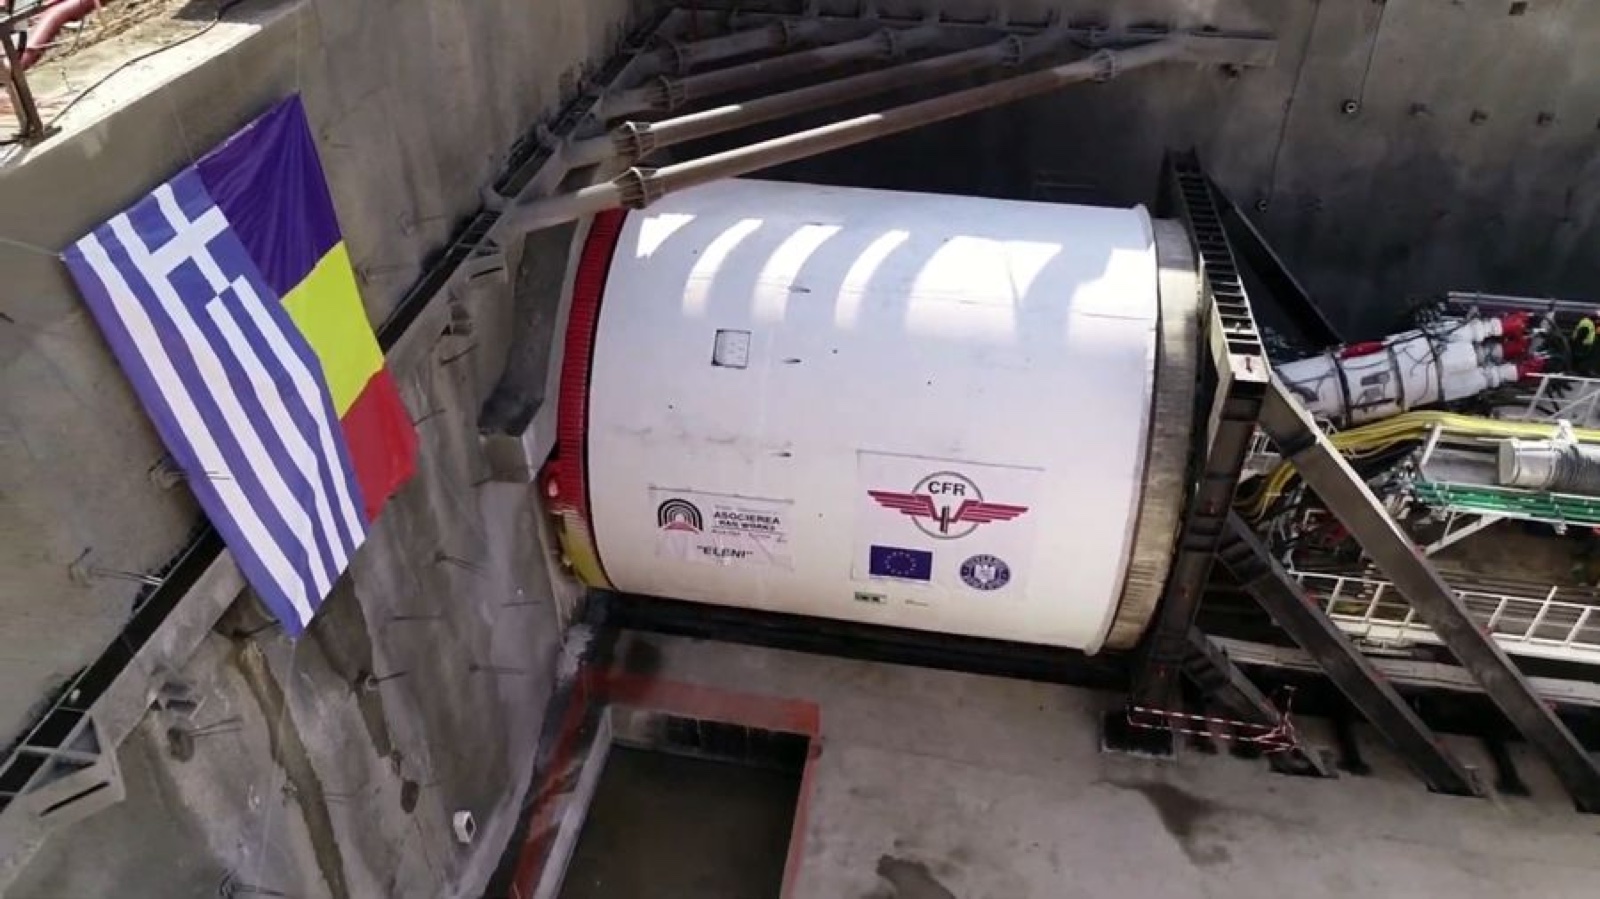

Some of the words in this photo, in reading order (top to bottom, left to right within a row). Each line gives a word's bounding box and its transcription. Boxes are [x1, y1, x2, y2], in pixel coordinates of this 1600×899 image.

[928, 481, 966, 496] CFR
[713, 511, 780, 525] ASOCIEREA
[697, 545, 754, 559] "ELENI"
